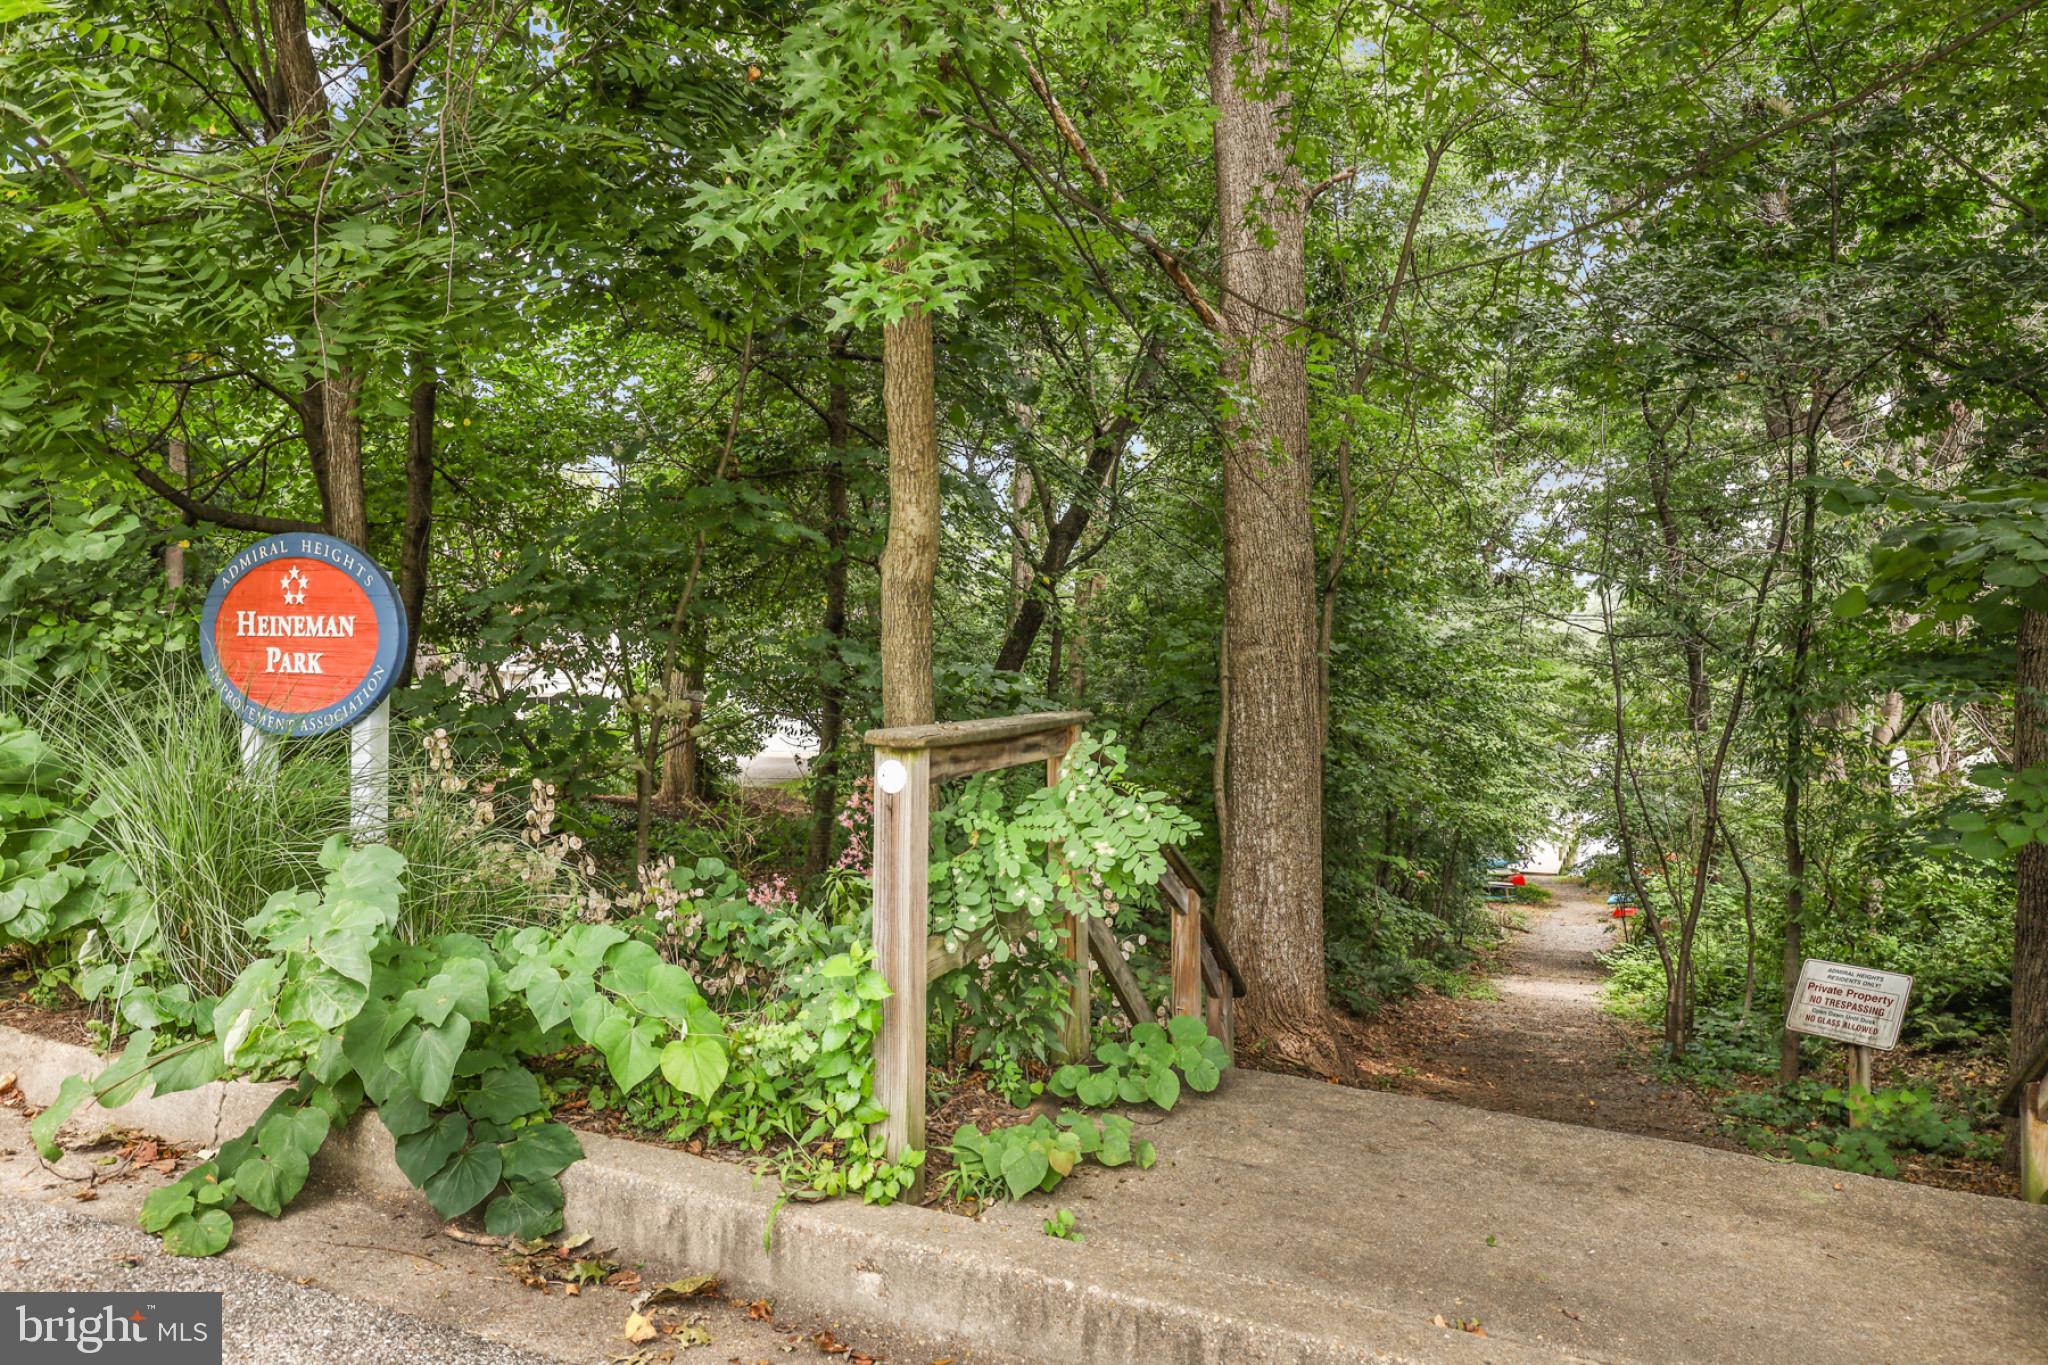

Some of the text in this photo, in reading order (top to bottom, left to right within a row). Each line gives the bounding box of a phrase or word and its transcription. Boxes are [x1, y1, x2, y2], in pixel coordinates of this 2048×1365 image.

[222, 539, 374, 589] ADMIRAL HEIGHTS
[236, 610, 356, 638] HEINEMAN
[265, 646, 324, 674] PARK
[300, 665, 385, 732] ASSOCIATION
[1826, 974, 1861, 985] RESIDENTS
[1827, 967, 1885, 982] ADMIRAL HEIGHTS
[1807, 982, 1894, 1008] Private Property
[1809, 995, 1885, 1017] NO TRESPASSING
[1805, 1014, 1816, 1022] NO
[1817, 1016, 1840, 1028] GLASS
[1842, 1021, 1879, 1036] ALLOWED
[1812, 1008, 1827, 1016] Open
[1828, 1011, 1844, 1019] Dawn
[1860, 1017, 1875, 1025] Dusk
